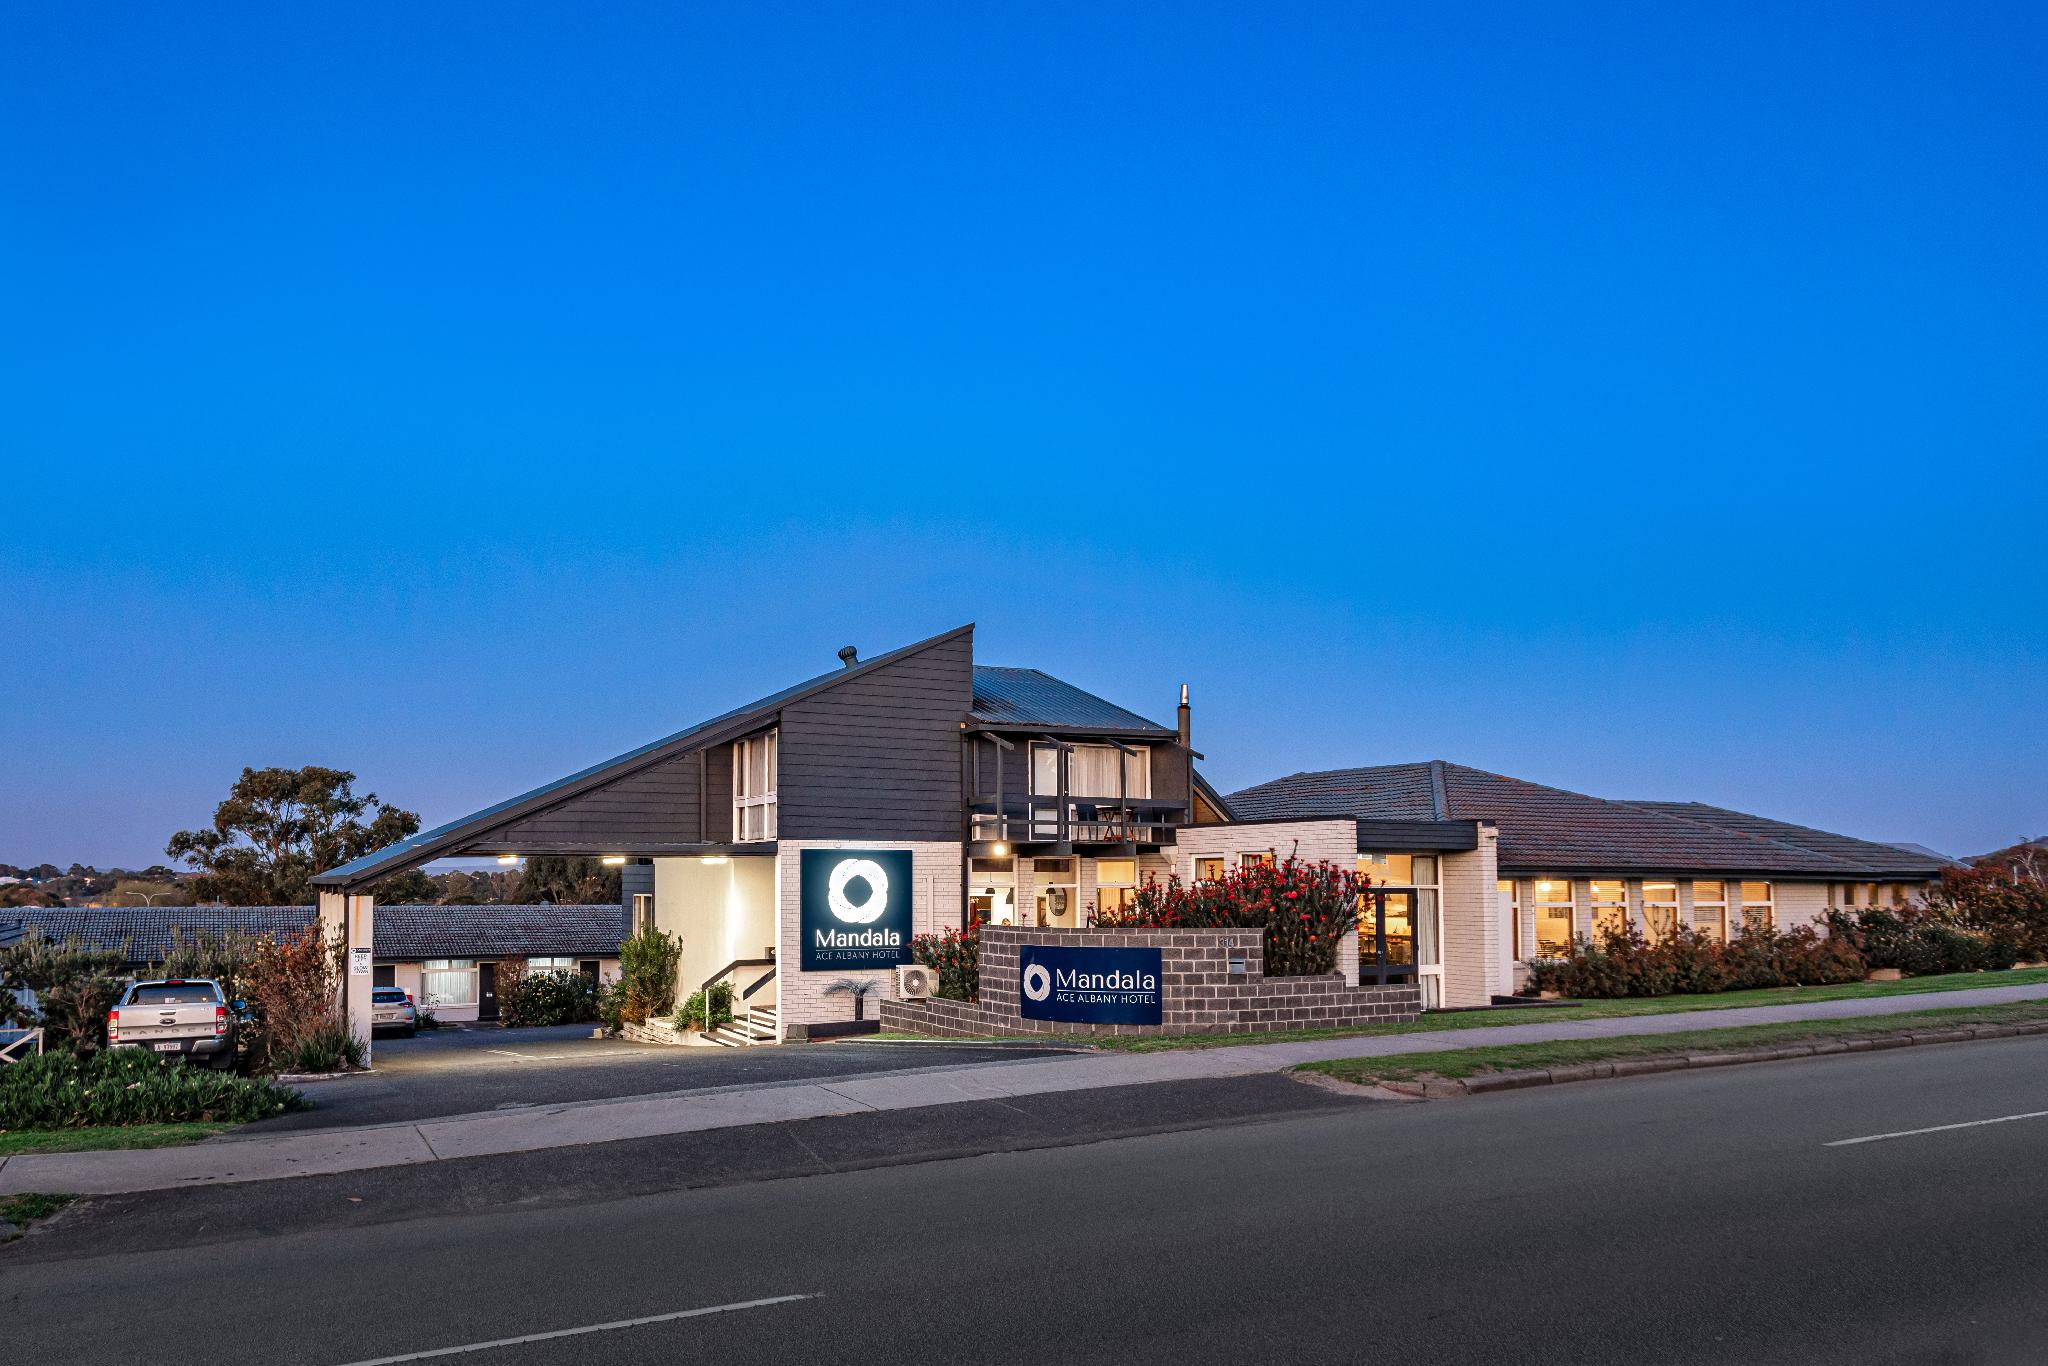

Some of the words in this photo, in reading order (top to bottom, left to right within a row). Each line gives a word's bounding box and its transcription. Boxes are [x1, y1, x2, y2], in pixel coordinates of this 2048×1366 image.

[816, 928, 900, 947] Mandala
[816, 951, 832, 960] ACE
[836, 951, 870, 960] ALBANY
[873, 950, 900, 959] HOTEL
[1056, 968, 1155, 989] Mandala
[1056, 993, 1075, 1002] ACE
[1077, 994, 1118, 1004] ALBANY
[1121, 995, 1156, 1004] HOTEL
[122, 1027, 212, 1036] RANGER
